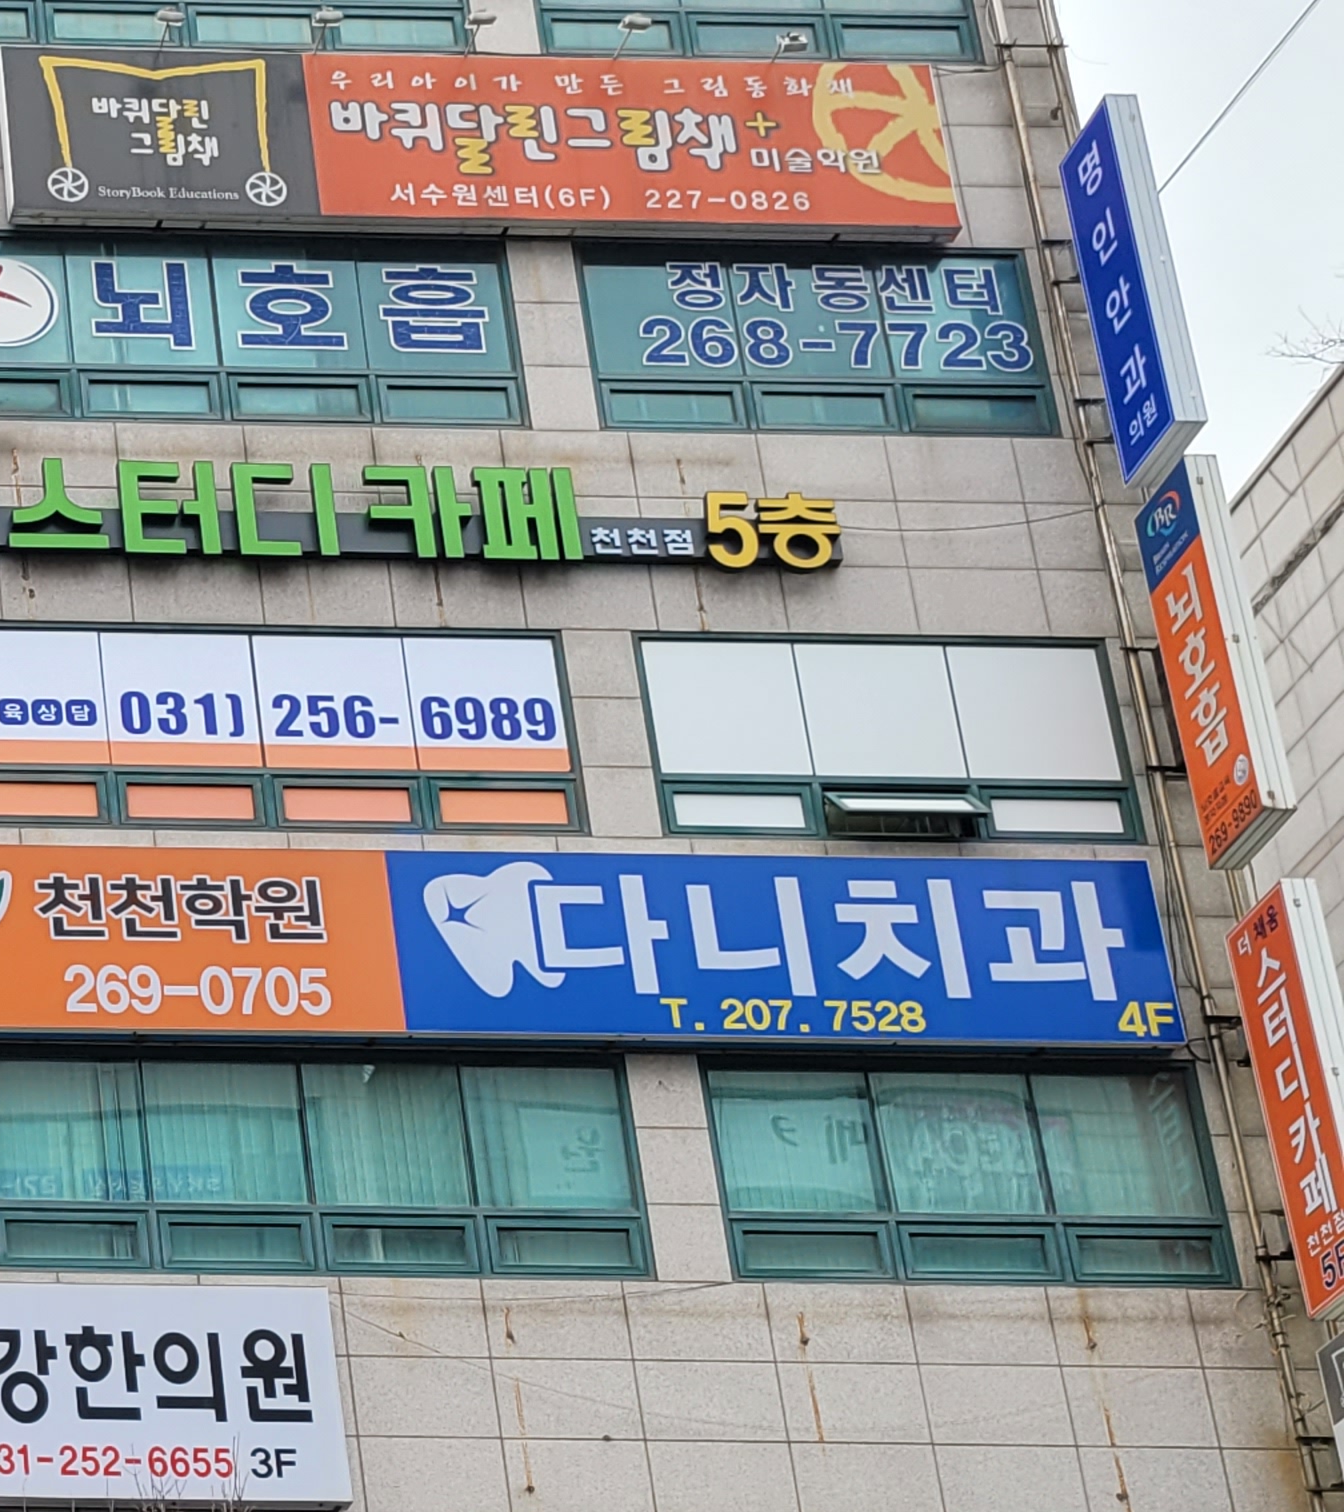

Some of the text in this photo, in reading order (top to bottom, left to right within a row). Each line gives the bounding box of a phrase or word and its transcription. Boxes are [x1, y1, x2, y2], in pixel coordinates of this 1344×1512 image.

[330, 69, 856, 101] 우리아이가 만든 그림동화책
[91, 97, 211, 133] 바퀴달린
[749, 144, 884, 177] 미술학원
[97, 185, 241, 201] StoryBook Educations
[644, 188, 812, 212] 227-0826
[89, 257, 490, 355] 뇌호흡
[664, 260, 1004, 316] 정자동센터
[638, 314, 1035, 374] 268-7723
[588, 523, 696, 559] 천천점
[702, 489, 842, 575] 5층
[1164, 562, 1230, 768] 뇌호흡
[1207, 790, 1259, 856] 269-9890
[33, 872, 330, 944] 천천학원
[534, 873, 1127, 1004] 다니치과
[62, 964, 333, 1018] 269-0705
[822, 1000, 927, 1035] 7528
[1117, 1001, 1176, 1038] 4F
[248, 1445, 298, 1482] 3F
